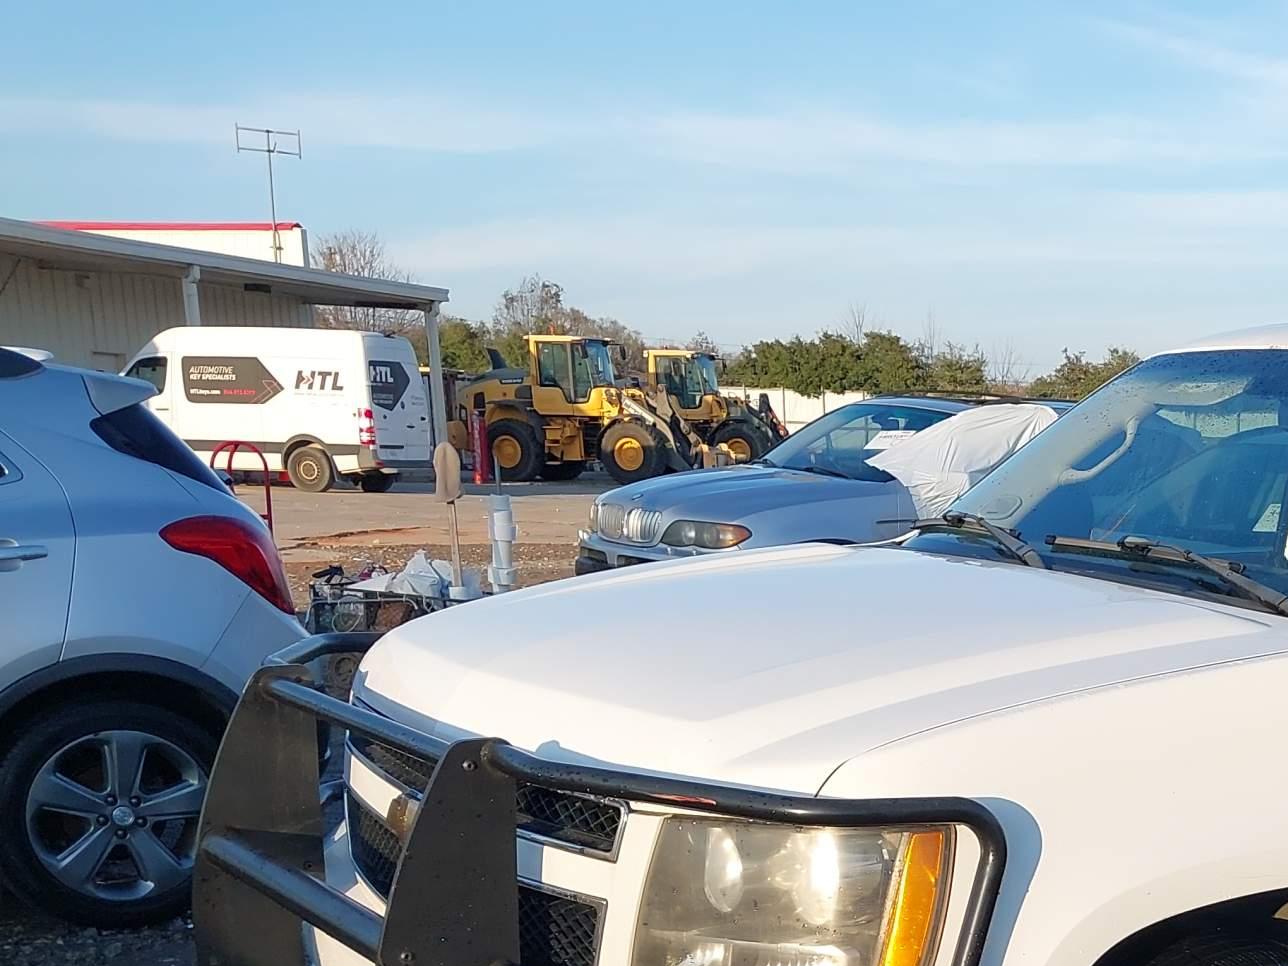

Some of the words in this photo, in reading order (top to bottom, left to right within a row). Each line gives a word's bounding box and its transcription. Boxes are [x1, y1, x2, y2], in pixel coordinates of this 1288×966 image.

[189, 365, 234, 374] AUTOMOTIVE
[371, 365, 394, 383] HTL
[189, 373, 201, 381] KEY
[201, 373, 236, 381] SPECIALISTS
[294, 370, 344, 391] HTL
